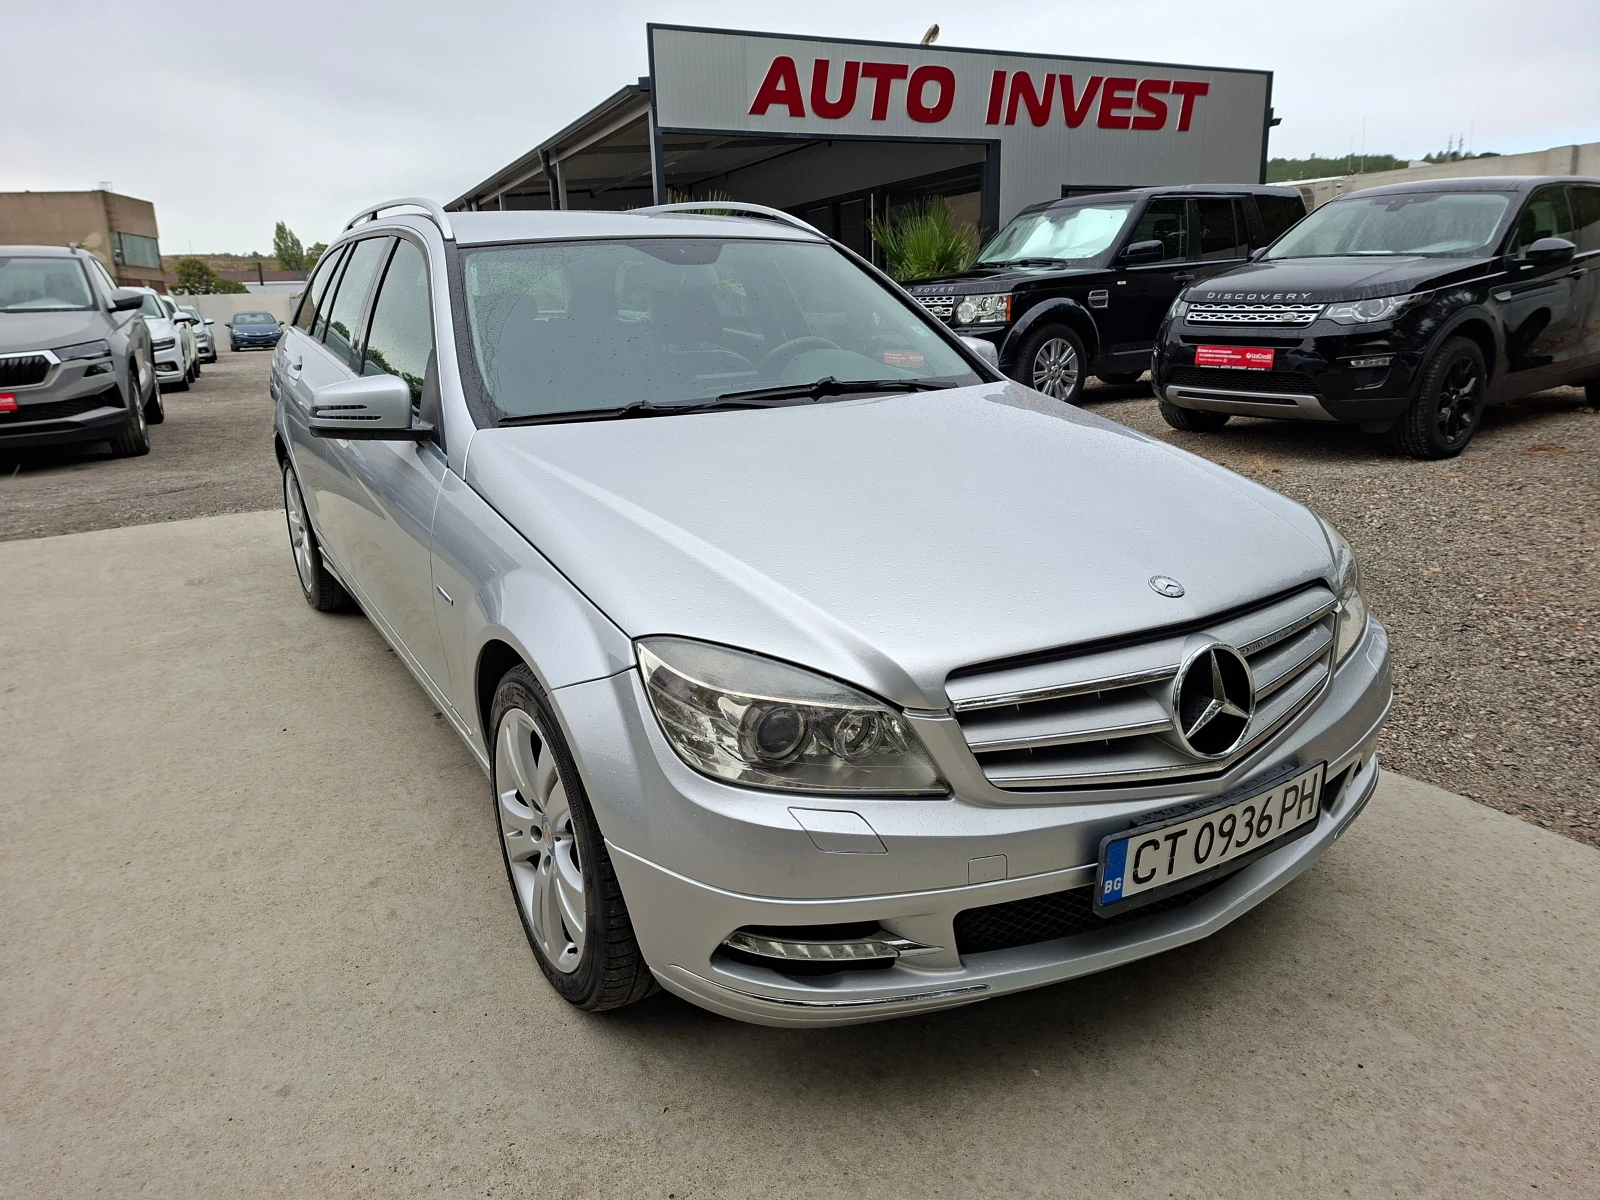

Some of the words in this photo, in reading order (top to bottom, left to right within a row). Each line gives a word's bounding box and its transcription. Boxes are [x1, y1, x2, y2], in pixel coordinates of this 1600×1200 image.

[749, 55, 956, 123] AUTO
[985, 69, 1209, 132] INVEST
[1206, 292, 1312, 300] DISCOVERY
[1132, 828, 1188, 885] CT
[1194, 796, 1273, 864] 0936
[1278, 772, 1319, 829] PH
[1104, 876, 1122, 895] BG
